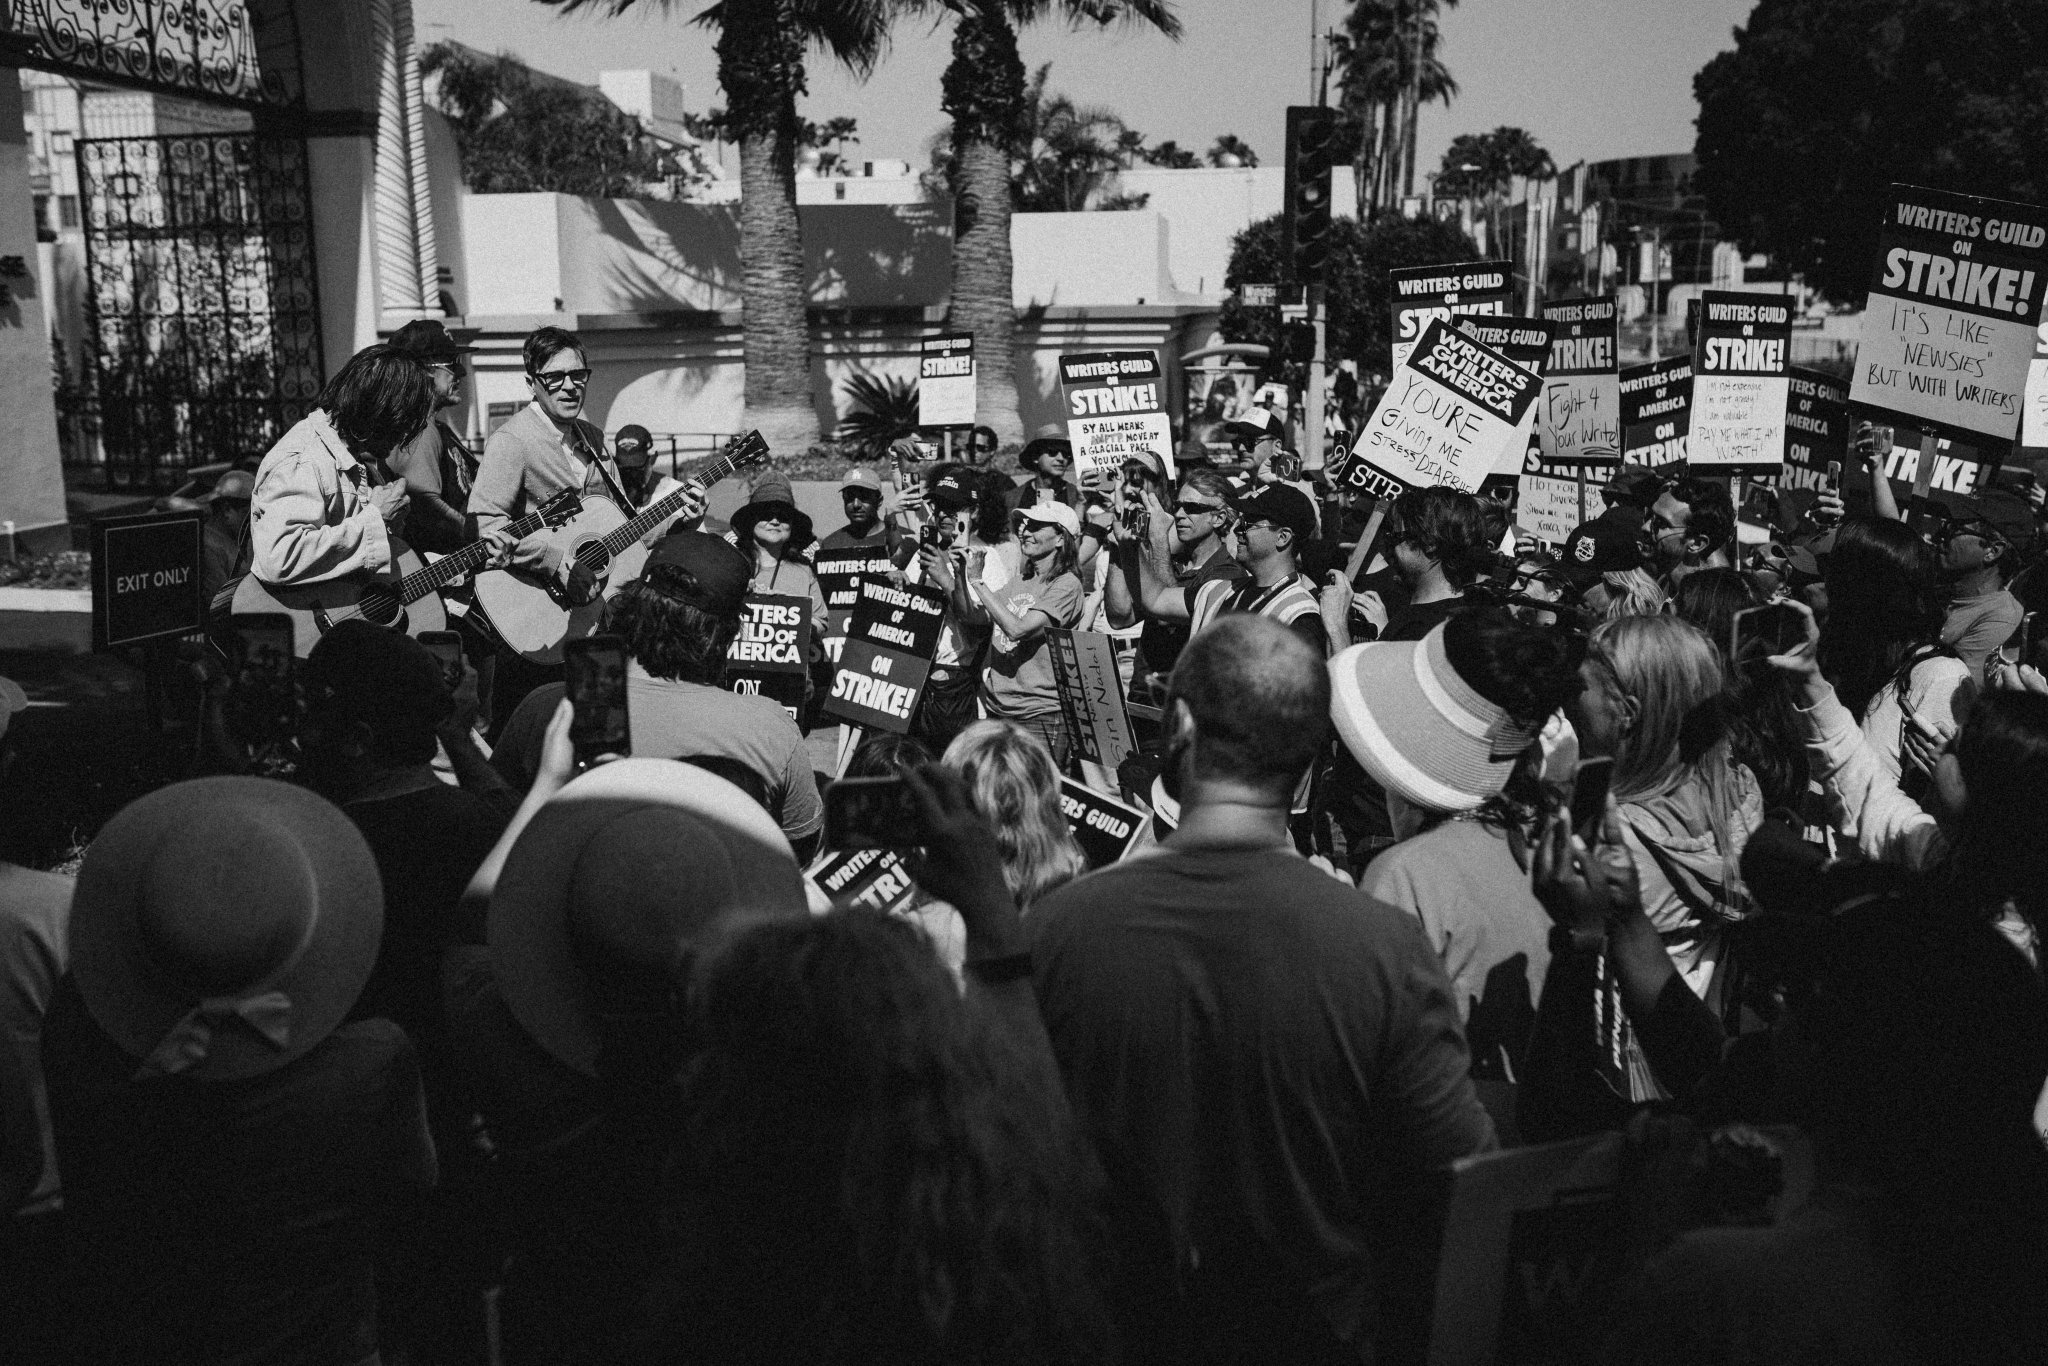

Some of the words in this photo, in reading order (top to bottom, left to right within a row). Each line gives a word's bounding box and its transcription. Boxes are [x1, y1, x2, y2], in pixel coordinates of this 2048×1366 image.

[1898, 203, 1982, 238] WRITERS
[1984, 219, 2046, 248] GUILD
[1953, 241, 1972, 256] ON
[1398, 276, 1461, 295] WRITERS
[1463, 273, 1504, 290] GUILD
[1882, 248, 2035, 315] STRIKE!
[1444, 294, 1458, 304] ON
[1544, 305, 1582, 322] WRITERS
[1585, 303, 1613, 320] GUILD
[1709, 304, 1756, 321] WRITERS
[1758, 306, 1787, 323] GUILD
[1892, 301, 1929, 334] IT'S
[1946, 314, 1994, 344] LIKE
[1473, 328, 1509, 344] ITERS
[1511, 330, 1547, 346] GUILD
[1572, 326, 1580, 335] ON
[1743, 325, 1753, 336] ON
[923, 355, 970, 376] STRIKE!
[1440, 329, 1529, 390] WRITERS
[1705, 337, 1784, 372] STRIKE!
[1066, 361, 1119, 378] WRITERS
[1120, 360, 1153, 373] GUILD
[1432, 345, 1495, 386] GUILD
[1494, 383, 1517, 399] OF
[1620, 372, 1668, 394] WRITERS
[1669, 365, 1692, 382] GUIL
[1107, 376, 1118, 385] ON
[1418, 355, 1512, 417] AMERICA
[1790, 378, 1816, 396] TERS
[1818, 385, 1847, 403] GUILD
[1868, 363, 1901, 387] BUT
[1909, 372, 1946, 397] WITH
[1956, 380, 2016, 415] WRITERS
[1070, 383, 1158, 415] STRIKE!
[1656, 388, 1667, 398] OF
[1401, 375, 1483, 444] YOU'RE
[1548, 384, 1585, 430] Fight
[1590, 386, 1599, 411] 4
[1639, 396, 1685, 418] AMERICA
[1800, 399, 1812, 412] OF
[1083, 424, 1096, 434] BY
[1100, 423, 1115, 432] ALL
[1118, 422, 1144, 431] MEANS
[1656, 422, 1674, 439] ON
[1787, 413, 1828, 436] MERICA
[1126, 432, 1147, 442] MOVE
[1149, 432, 1159, 440] AT
[1371, 432, 1417, 462] STRESS
[1381, 408, 1432, 454] Giving
[1439, 441, 1462, 466] ME
[1548, 426, 1577, 454] Your
[1080, 447, 1086, 456] A
[1089, 444, 1125, 455] GLACIAL
[1091, 455, 1108, 465] YOU
[1624, 435, 1687, 467] STRIK
[1790, 443, 1810, 463] ON
[817, 560, 866, 574] WRITERS
[117, 573, 149, 594] EXIT
[154, 566, 190, 587] ONLY
[864, 582, 911, 607] WRITERS
[911, 595, 942, 616] GUILD
[742, 603, 800, 626] TERS
[891, 610, 905, 623] OF
[775, 629, 797, 644] OF
[868, 622, 915, 647] AMERICA
[871, 655, 892, 676] ON
[734, 679, 761, 695] ON
[831, 668, 916, 719] STRIKE!
[1060, 637, 1098, 757] STRIKE!
[1086, 809, 1130, 838] GUILD
[880, 851, 897, 868] ON
